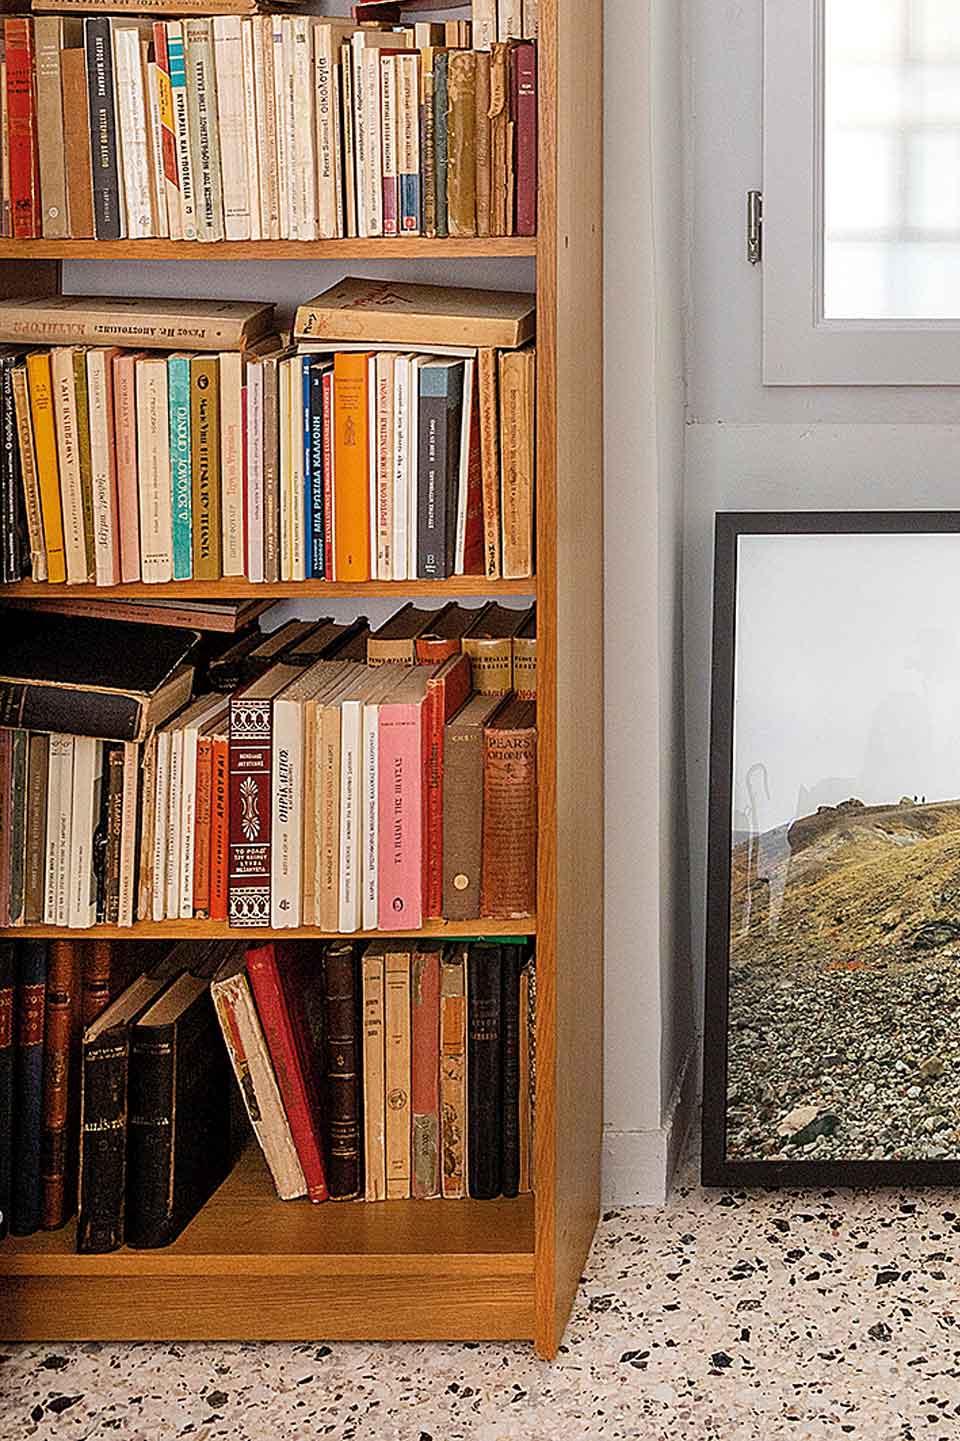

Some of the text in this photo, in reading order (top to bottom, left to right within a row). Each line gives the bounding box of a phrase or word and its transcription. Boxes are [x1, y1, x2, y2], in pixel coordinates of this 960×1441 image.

[94, 36, 105, 61] ΠΕΤΡΟΣ
[175, 93, 188, 137] ΚΥΡΙΑΡΧΙΑ
[178, 139, 188, 153] ΚΑΙ
[311, 416, 322, 532] ΜΙΑ ΡΩΣΙΔΑ ΚΑΛΛΟΝΗ
[488, 737, 531, 749] PEARS
[394, 797, 402, 814] ΤΗΣ
[394, 818, 402, 848] ΠΑΙΔΙΑ
[394, 852, 402, 864] ΤΑ
